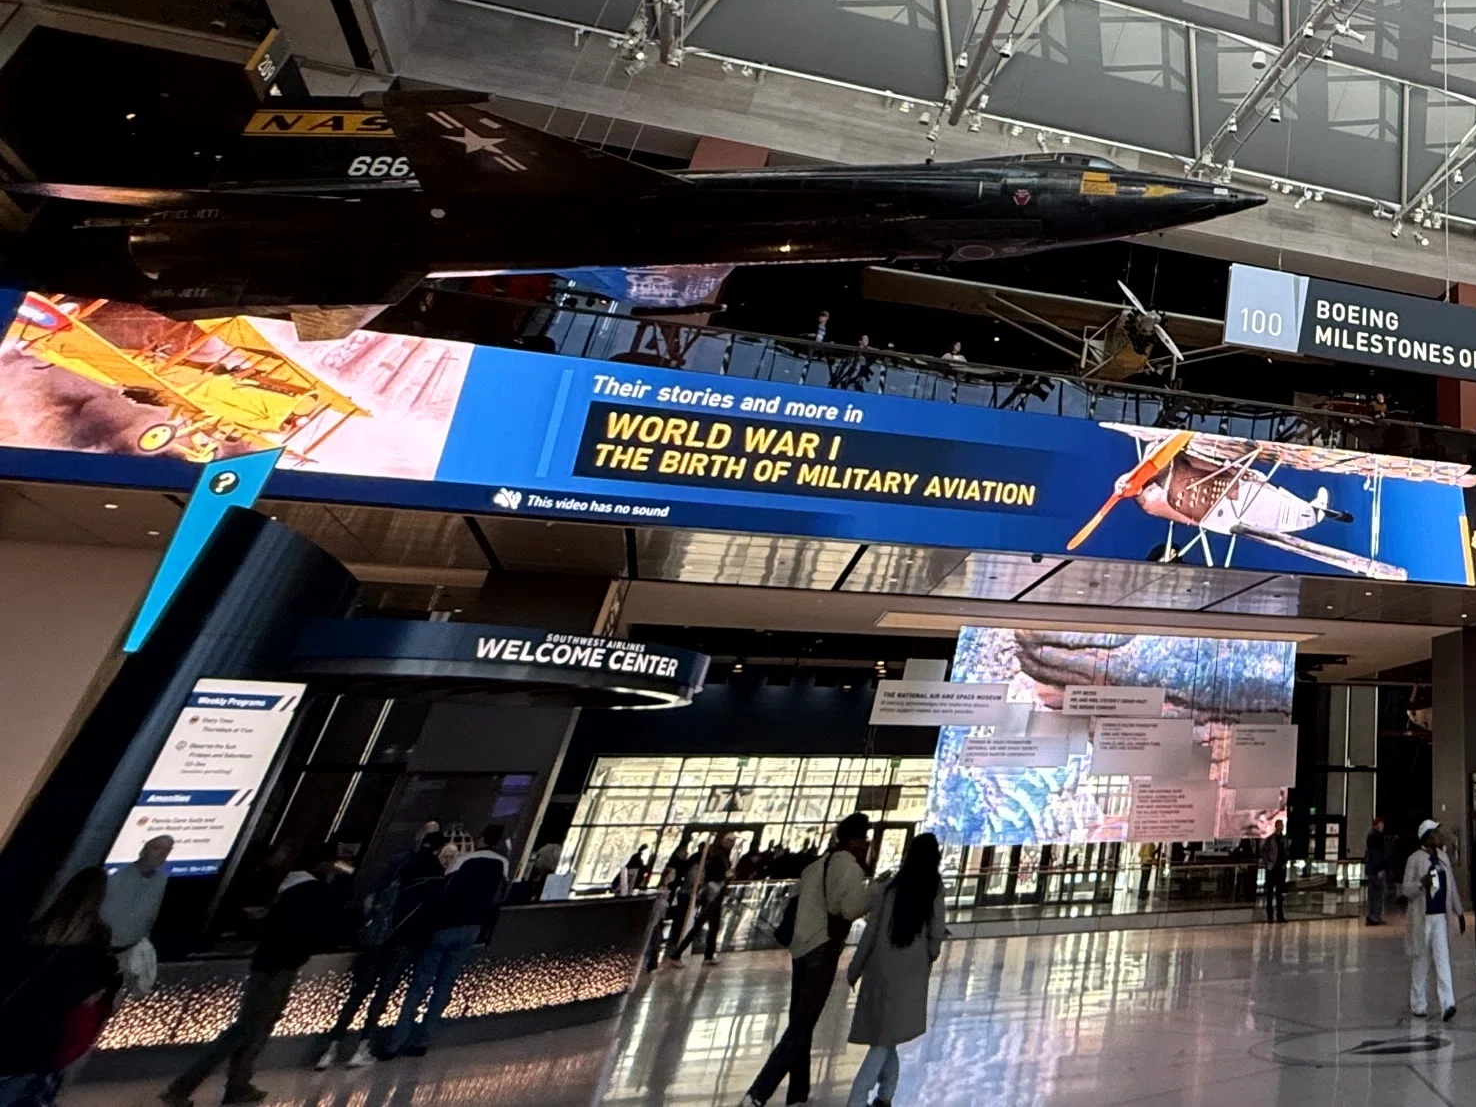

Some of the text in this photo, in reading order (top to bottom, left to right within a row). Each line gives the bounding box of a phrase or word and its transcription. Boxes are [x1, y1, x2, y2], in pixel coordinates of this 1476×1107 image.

[260, 115, 391, 132] NAS
[348, 156, 416, 177] 666
[1240, 308, 1282, 336] 100
[1316, 299, 1399, 330] BOEING
[1315, 325, 1455, 365] MILESTONES
[591, 374, 863, 424] Their stories and more in
[605, 411, 842, 461] WORLD WAR I
[594, 443, 1036, 506] THE BIRTH OF MILITARY AVIATION
[527, 494, 670, 517] This video has no sound
[476, 637, 679, 678] WELCOME CENTER
[546, 633, 646, 653] SOUTHWEST AIRLINES
